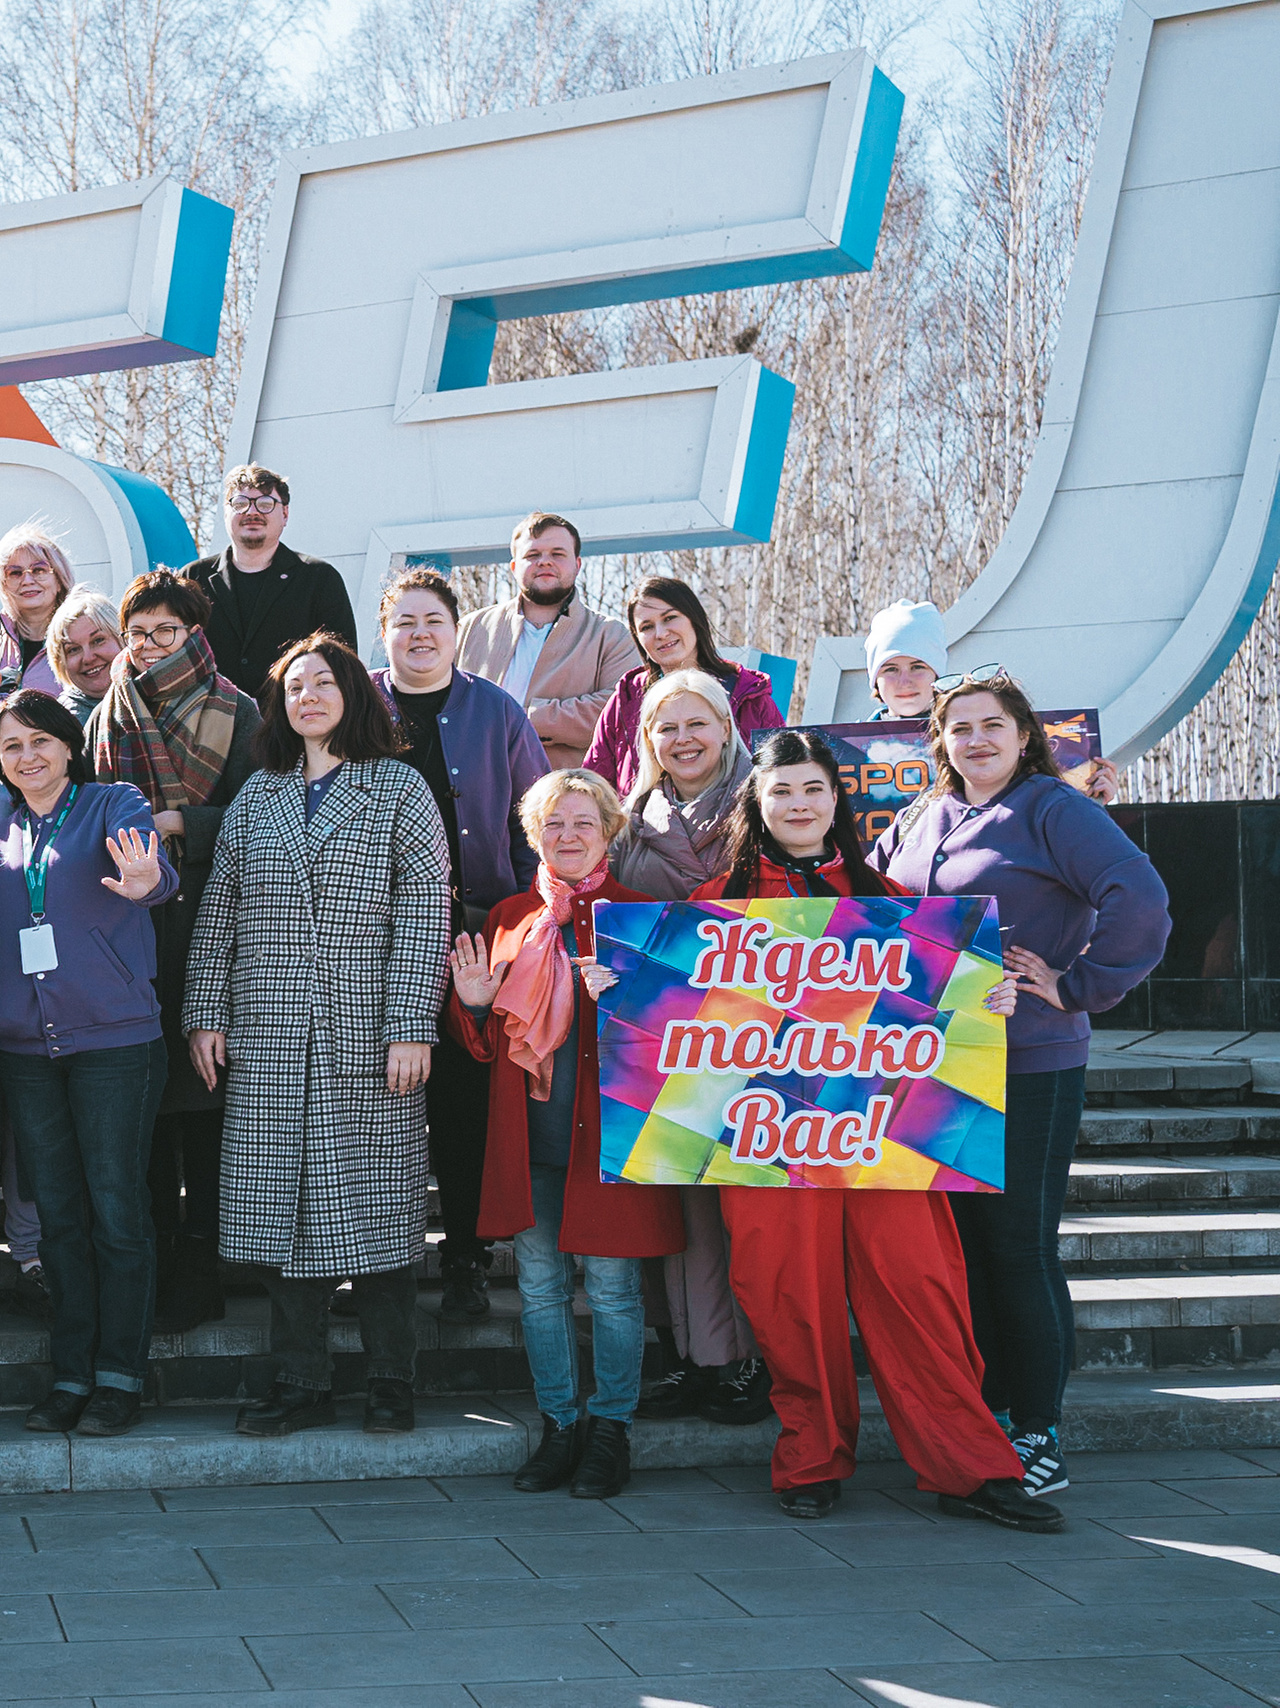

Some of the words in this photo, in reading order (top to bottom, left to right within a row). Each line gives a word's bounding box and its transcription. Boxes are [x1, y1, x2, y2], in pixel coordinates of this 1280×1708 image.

[693, 920, 908, 1005] Ждем
[662, 1022, 940, 1074] только
[727, 1093, 889, 1163] Вас!
